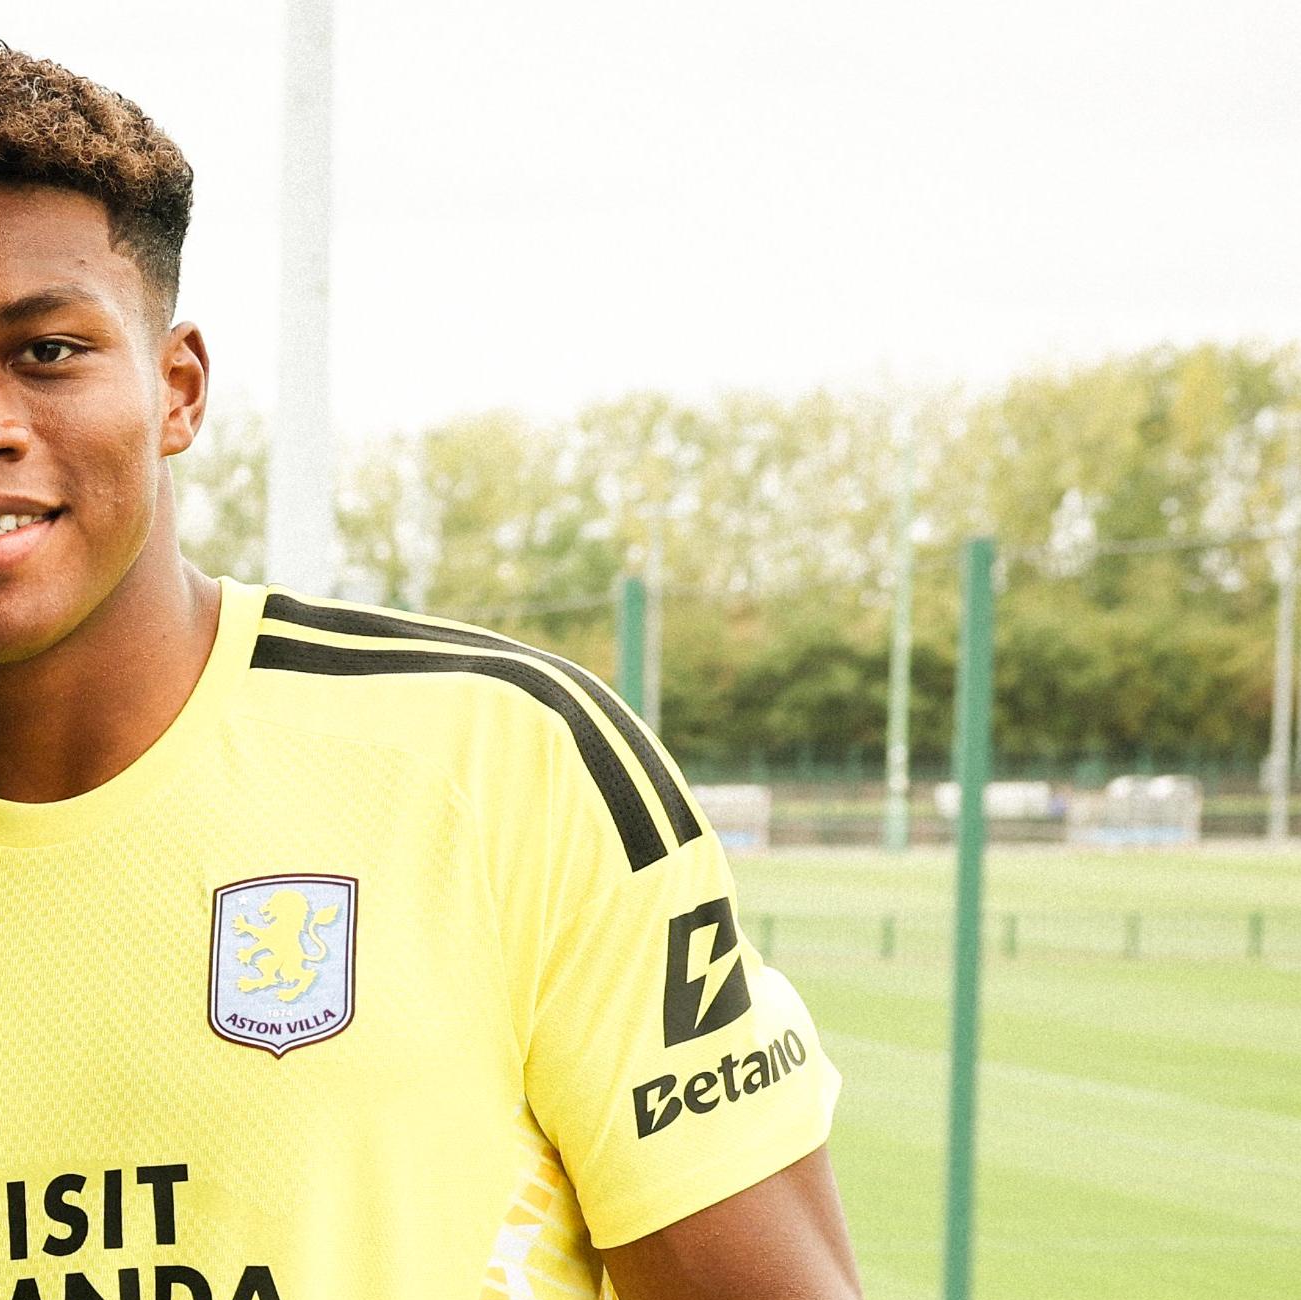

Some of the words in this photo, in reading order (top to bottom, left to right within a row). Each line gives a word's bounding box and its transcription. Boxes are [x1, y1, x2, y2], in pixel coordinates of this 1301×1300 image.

[225, 1013, 282, 1035] ASTON
[286, 1008, 337, 1034] VILLA
[632, 1029, 807, 1139] Betano
